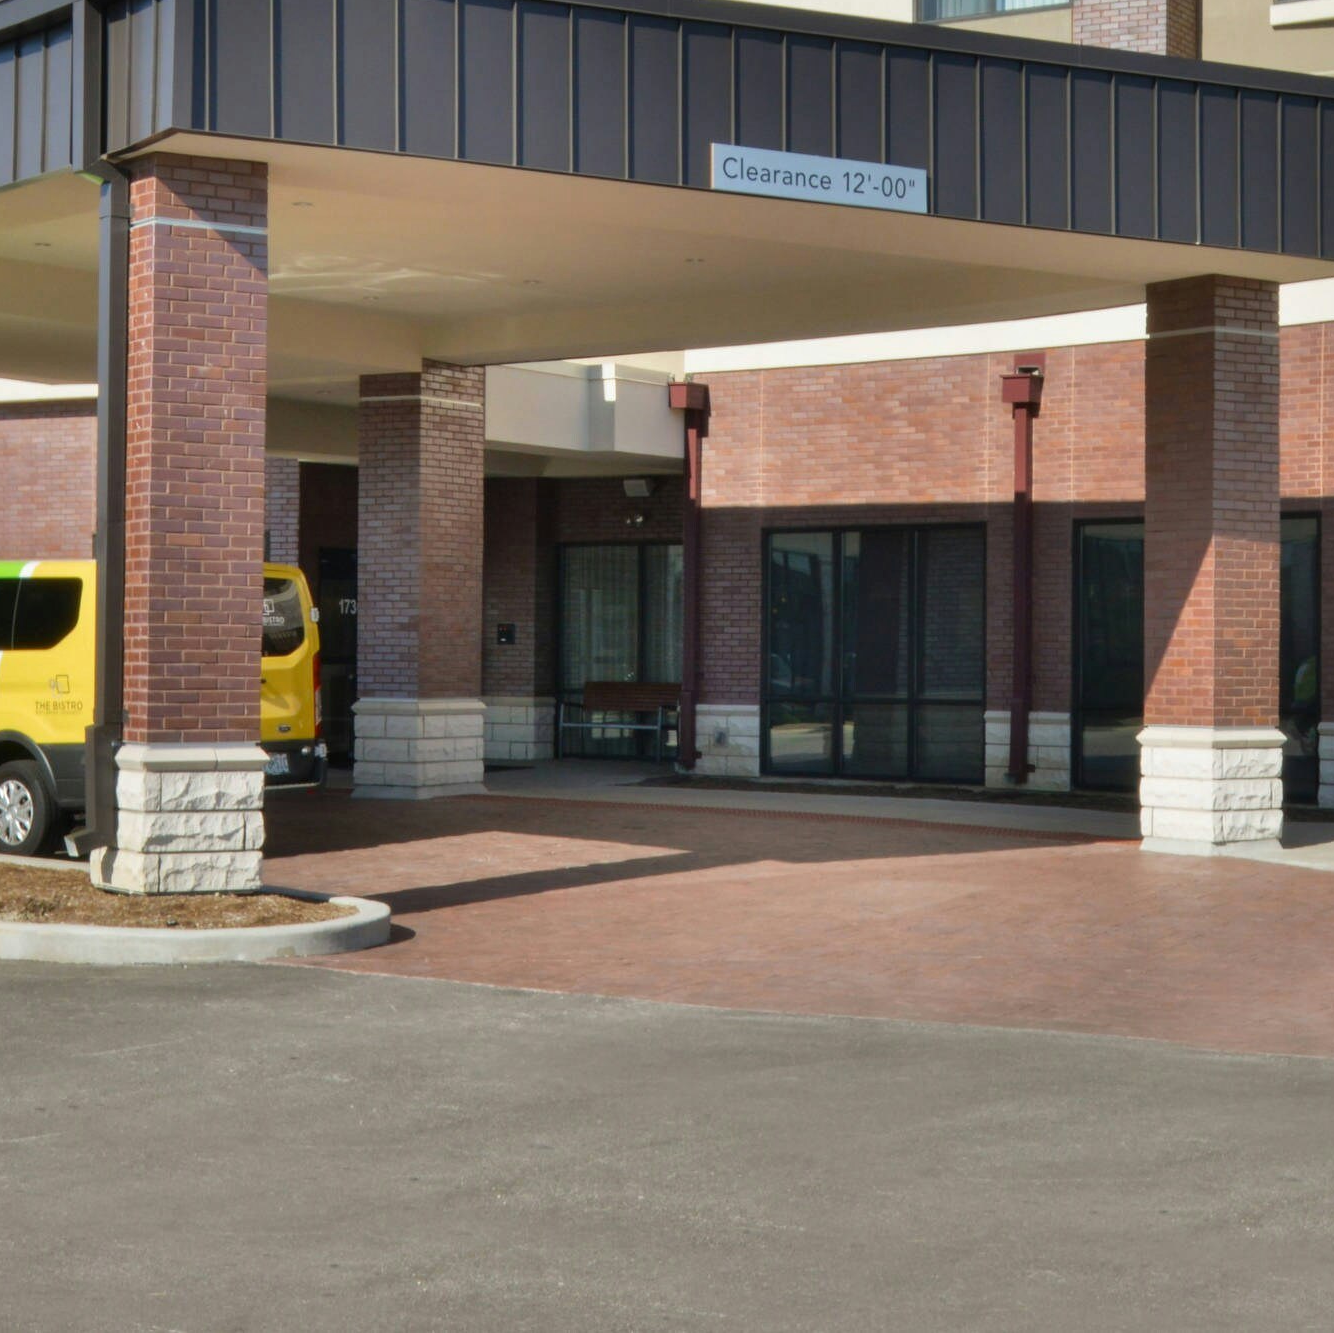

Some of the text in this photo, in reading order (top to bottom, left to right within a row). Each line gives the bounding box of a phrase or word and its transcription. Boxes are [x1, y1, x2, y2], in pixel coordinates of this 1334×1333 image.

[722, 157, 915, 199] Clearance 12'-00"
[35, 700, 83, 711] THE BISTRO
